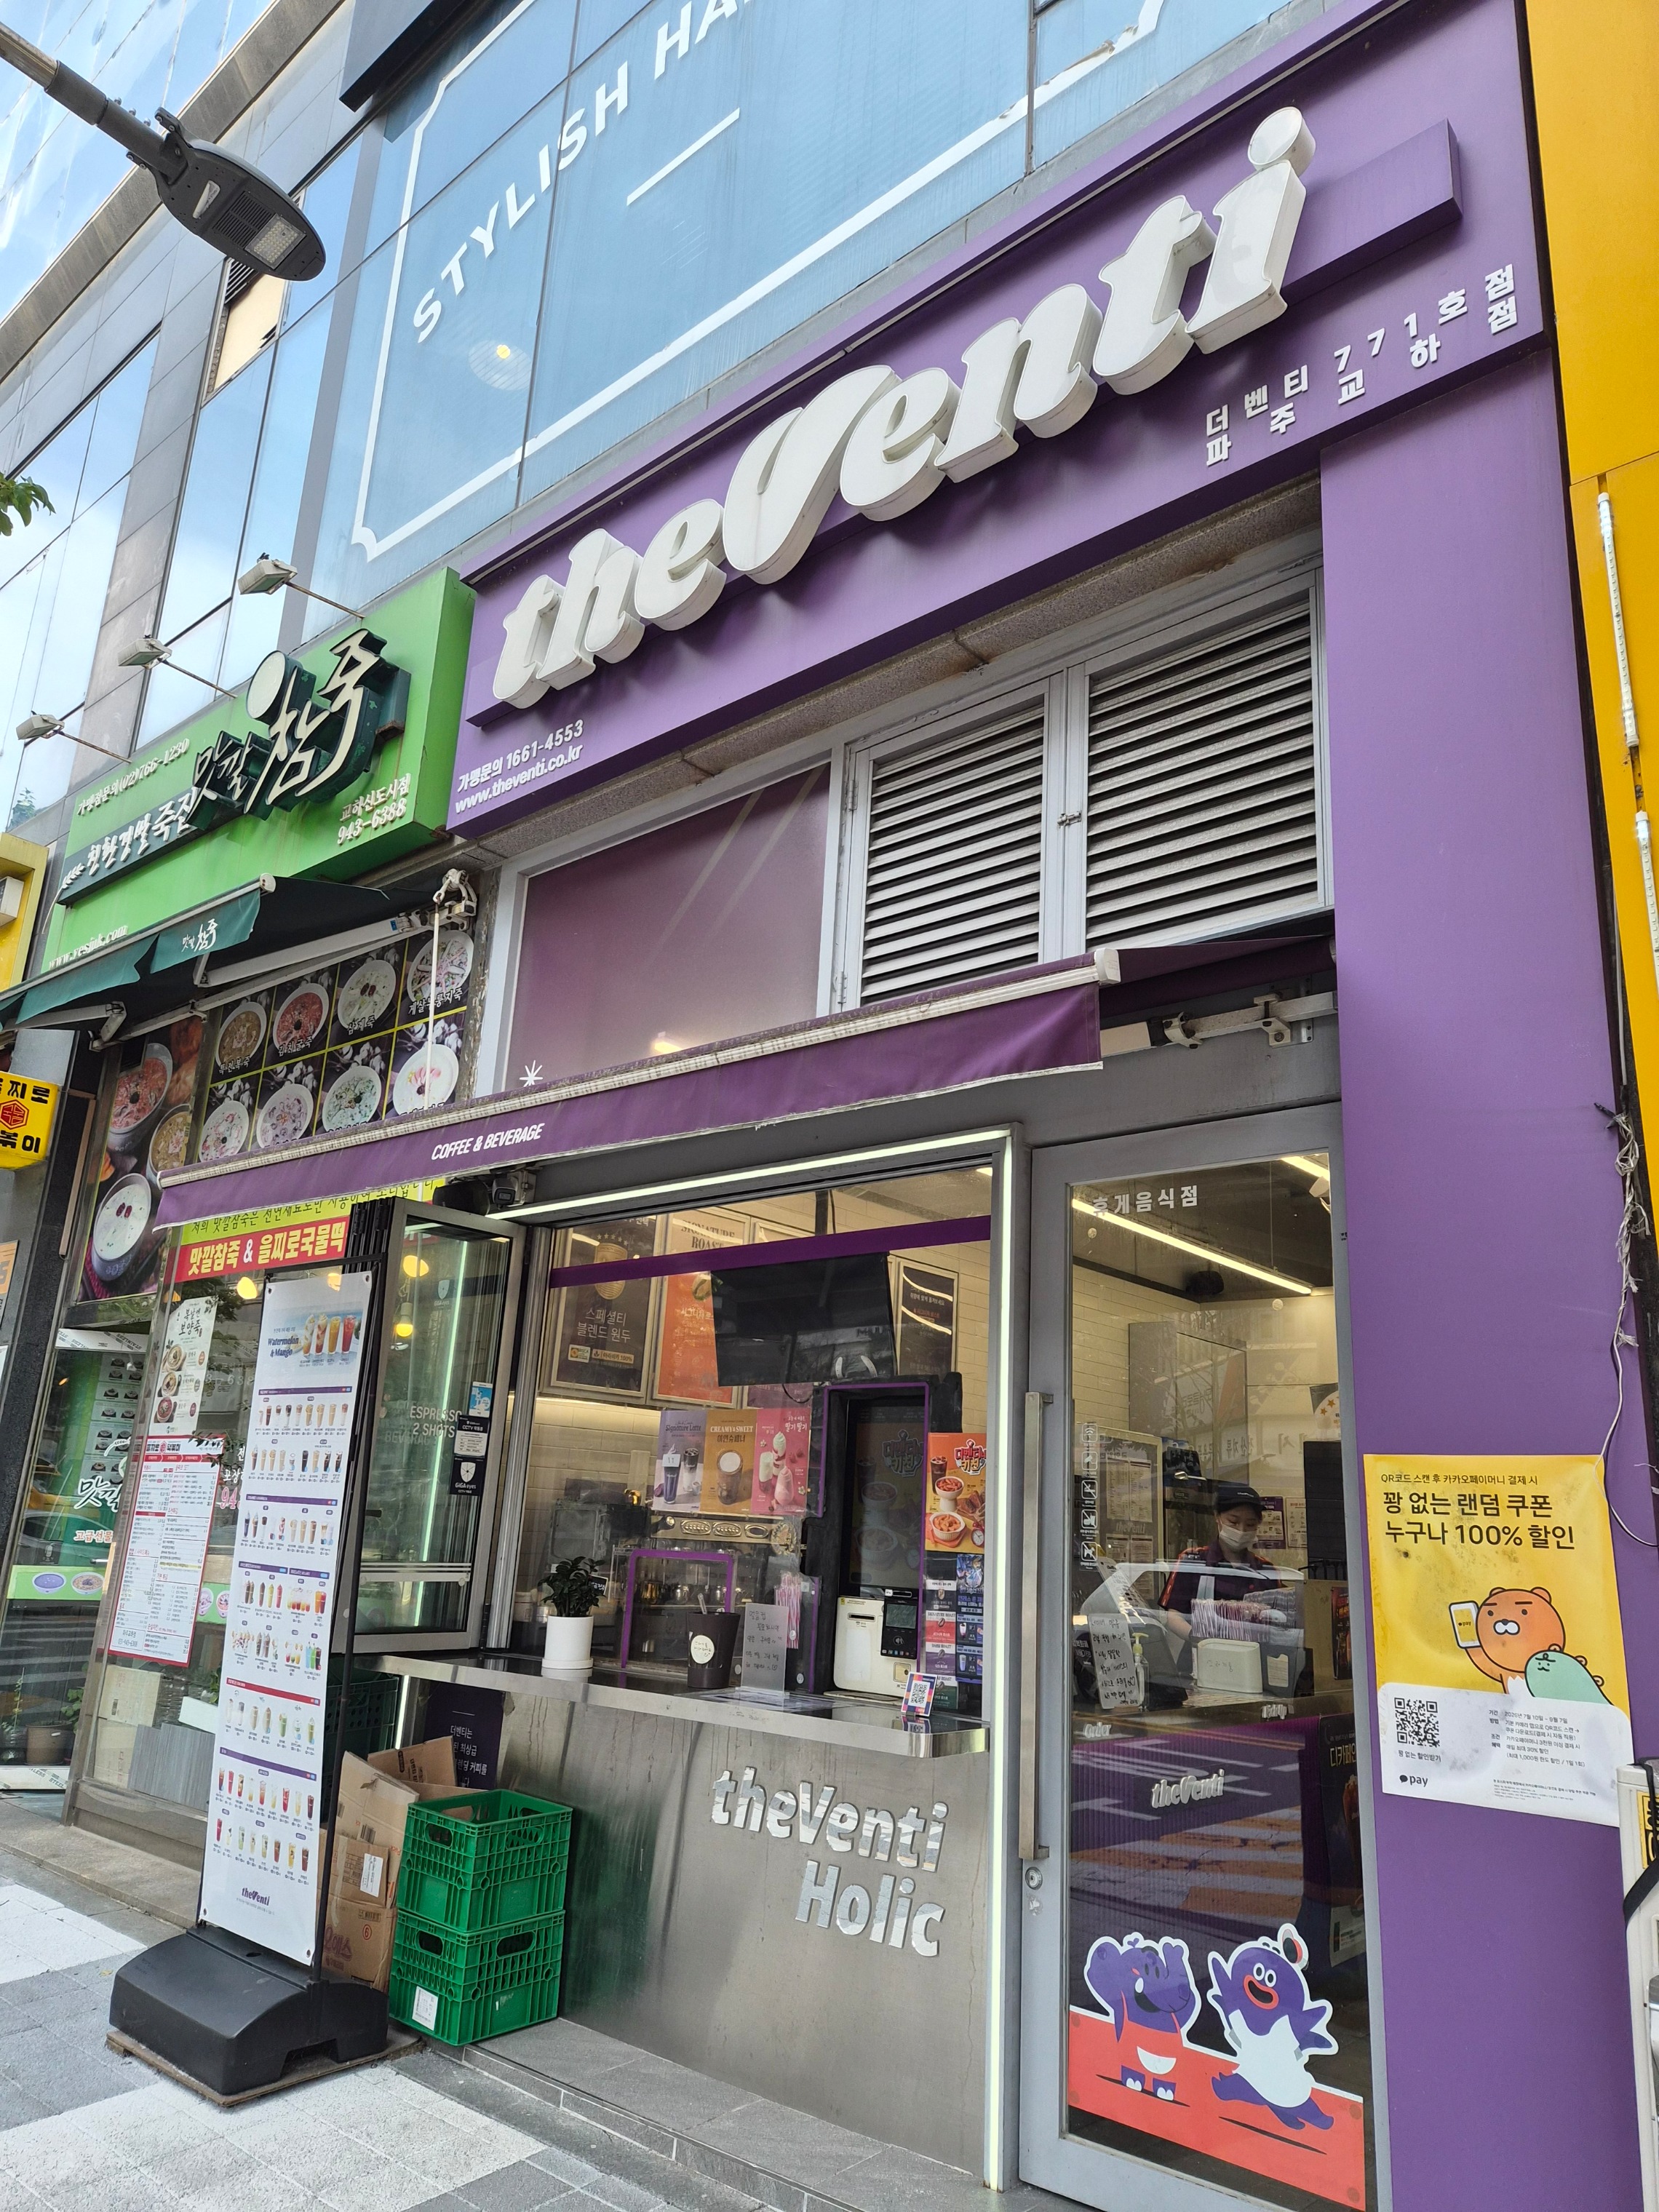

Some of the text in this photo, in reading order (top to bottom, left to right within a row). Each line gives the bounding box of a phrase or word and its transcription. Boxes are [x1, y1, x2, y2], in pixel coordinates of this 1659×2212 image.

[413, 0, 747, 343] STYLISH HA
[493, 106, 1316, 708] theVenti
[457, 720, 584, 792] 가맹문의 1661-4553
[455, 742, 583, 813] www.theventi.co.kr
[340, 773, 412, 822] 교하신도시점
[337, 797, 407, 846] 943-6388
[0, 1078, 50, 1105] 찌로
[431, 1123, 546, 1161] COFFEE & BEVERAGE
[1093, 1185, 1198, 1217] 휴게음식점
[191, 1220, 209, 1234] 저희
[188, 1238, 241, 1277] 맛깔참죽
[242, 1239, 254, 1265] &
[585, 1308, 627, 1326] 스페셜티
[268, 1336, 299, 1346] Watermelon
[576, 1321, 632, 1343] 블렌드 원두
[274, 1348, 293, 1358] Mango
[410, 1405, 462, 1423] ESPRESSO
[413, 1422, 455, 1439] 2 SHOTS
[1381, 1473, 1538, 1486] QR코드 스캔 후 카카오페이머니 결제 시
[220, 1487, 241, 1510] 94
[1383, 1492, 1553, 1518] 꽝 없는 랜덤 쿠폰
[1385, 1520, 1575, 1550] 누구나 100% 할인
[450, 1725, 473, 1739] 더벤티는
[1506, 1735, 1538, 1745] 카카오페이머니
[460, 1743, 477, 1757] 최상급
[1404, 1751, 1416, 1759] 없는
[1417, 1752, 1441, 1762] 할인받기
[1519, 1754, 1539, 1762] 1,000원
[454, 1759, 488, 1776] 렌딩 커피를
[1152, 1769, 1225, 1809] theVenti
[1409, 1775, 1428, 1788] pay
[710, 1766, 949, 1873] theVenti
[242, 1887, 271, 1906] theVenti
[795, 1859, 946, 1957] Holic
